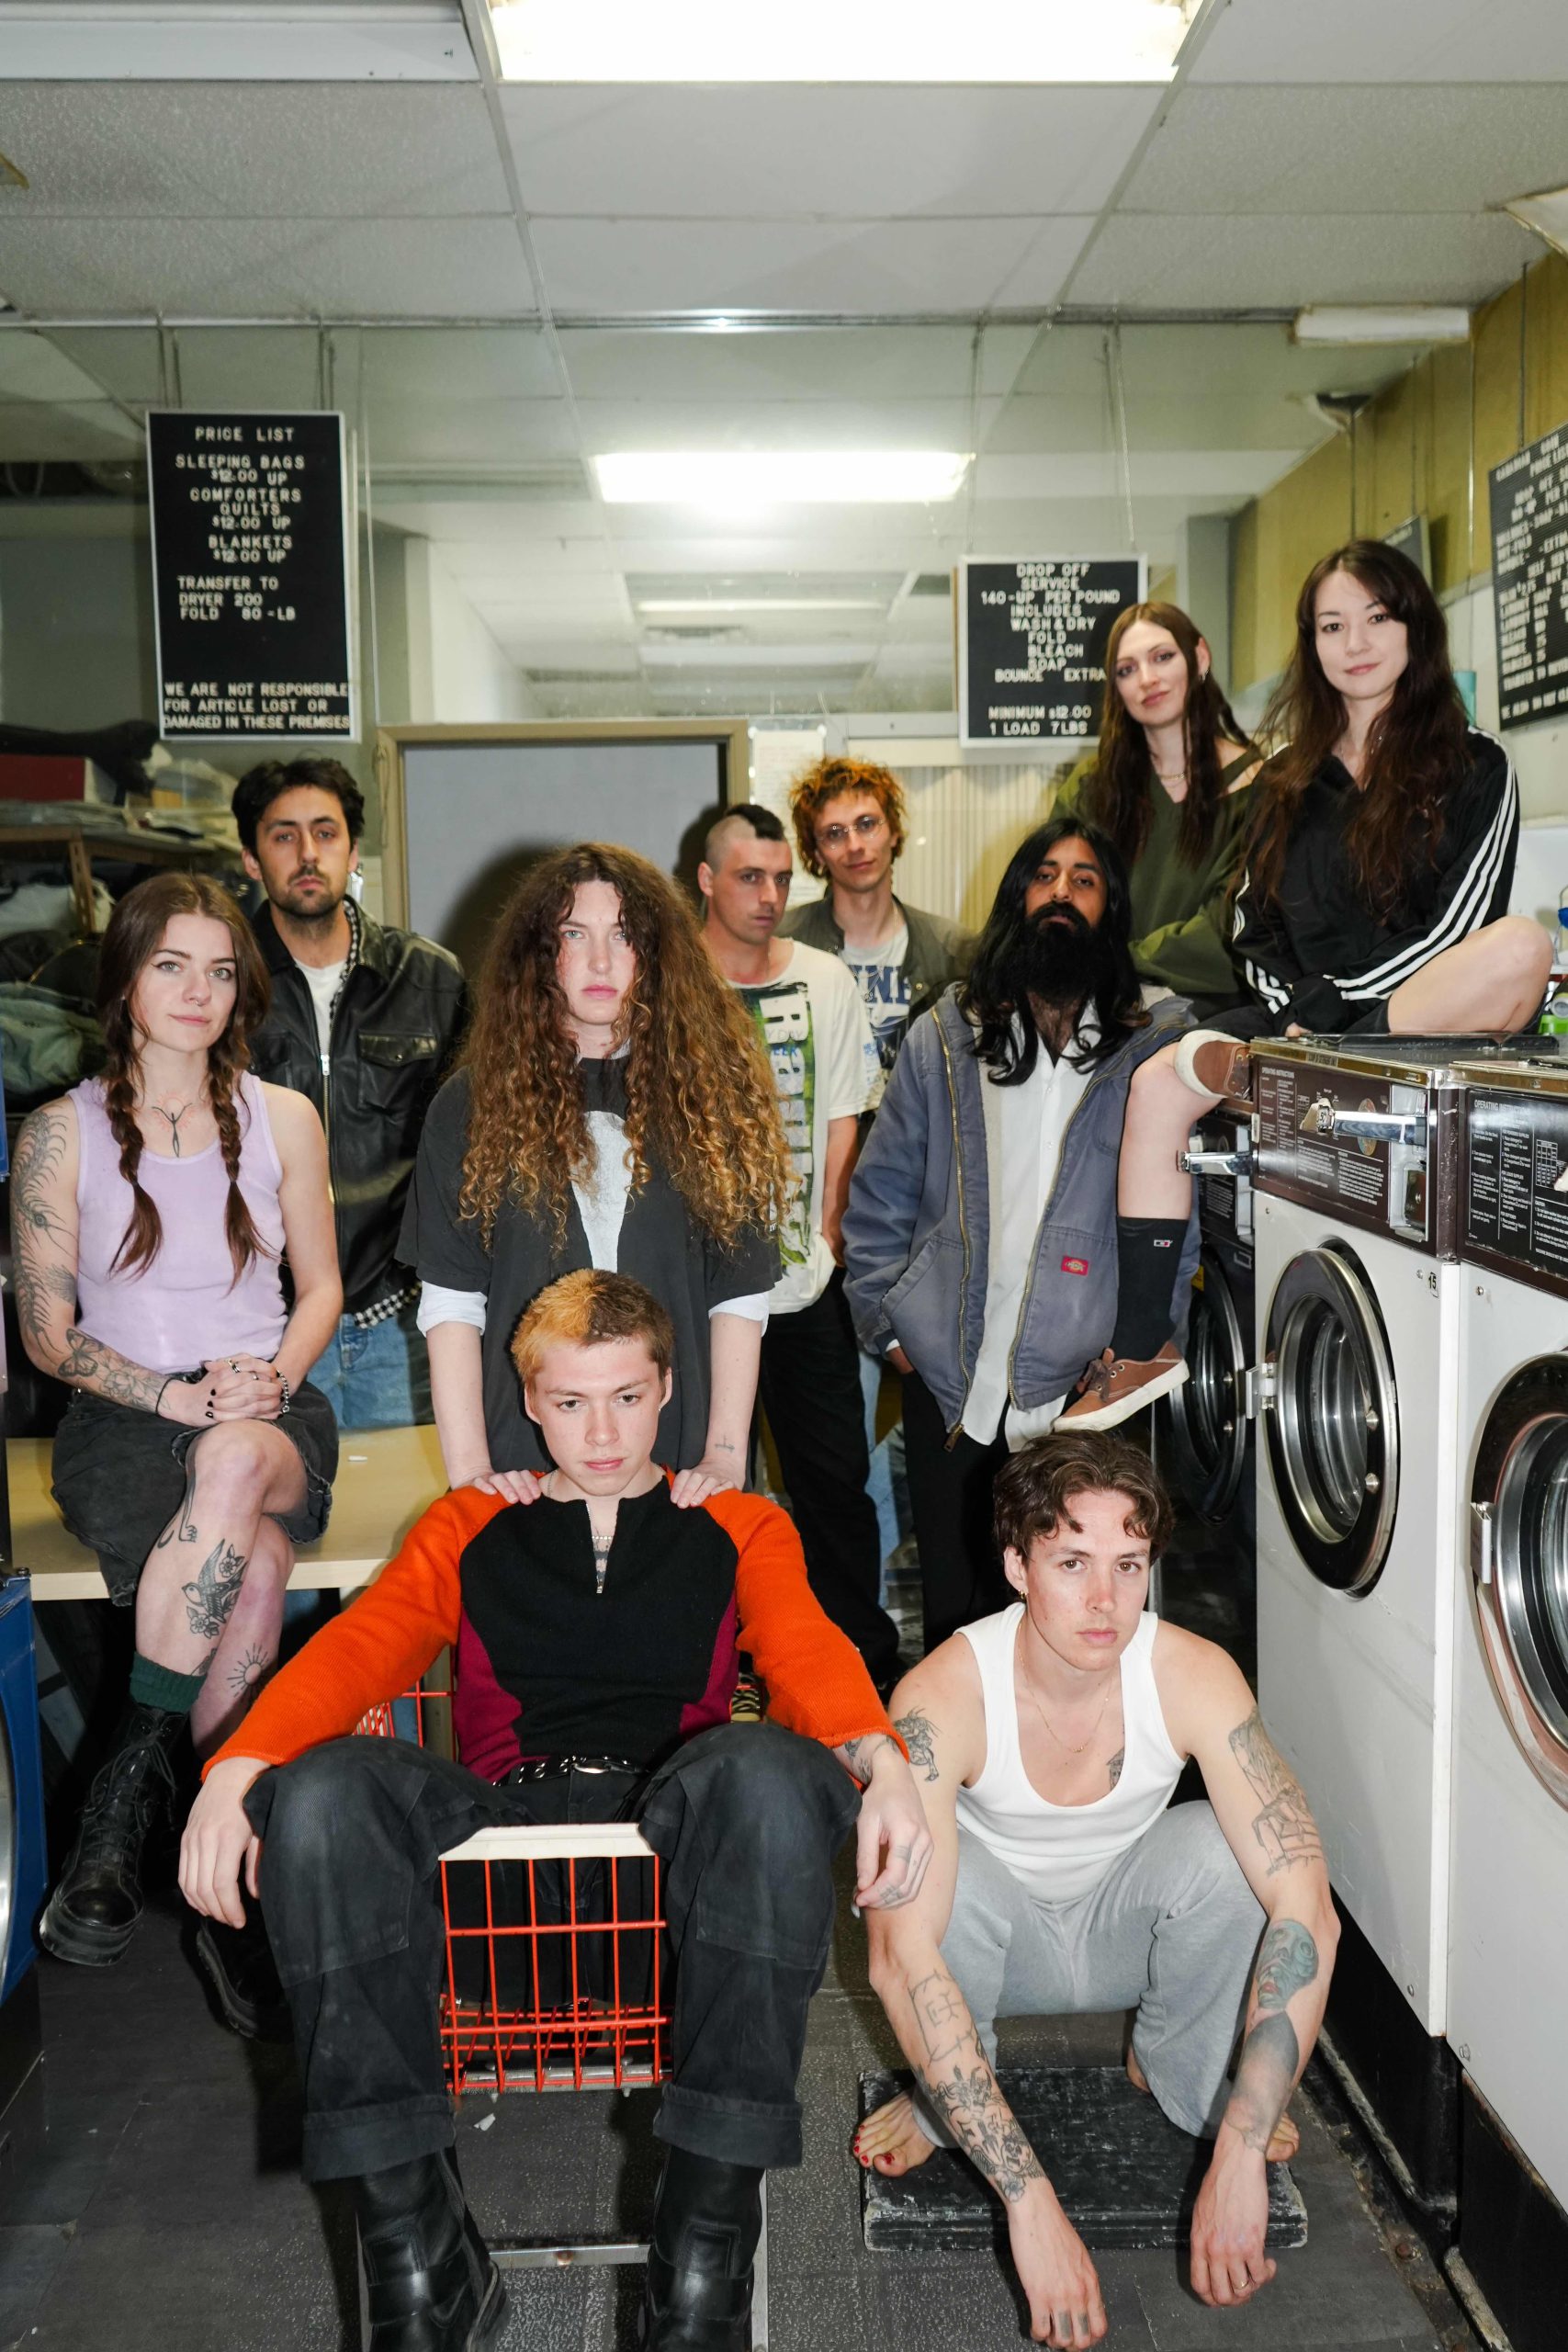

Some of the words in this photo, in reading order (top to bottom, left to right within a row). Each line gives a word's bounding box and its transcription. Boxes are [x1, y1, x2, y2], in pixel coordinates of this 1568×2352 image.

[195, 426, 243, 441] PRICE
[256, 426, 294, 442] LIST
[175, 454, 251, 469] SLEEPING
[260, 454, 305, 469] BAGS
[266, 471, 288, 486] UP
[190, 487, 301, 503] COMFORTERS
[220, 502, 280, 516] QUILTS
[272, 515, 291, 530] UP
[209, 534, 292, 549] BLANKETS
[267, 548, 287, 563] UP
[1016, 563, 1055, 577] DROP
[1062, 563, 1090, 576] OFF
[177, 575, 251, 590] TRANSFER
[259, 575, 279, 591] TO
[1021, 577, 1080, 591] SERVICE
[179, 592, 223, 606] DRYER
[234, 592, 263, 606] 200
[1044, 591, 1072, 604] PER
[1076, 590, 1121, 604] POUND
[180, 606, 220, 620] FOLD
[1010, 604, 1082, 617] INCLUDES
[1010, 617, 1051, 631] WASH
[1066, 617, 1096, 630] DRY
[1028, 630, 1066, 644] FOLD
[1028, 644, 1084, 658] BLEACH
[1028, 658, 1066, 672] SOAP
[995, 669, 1043, 683] BOUNCE
[1064, 668, 1107, 682] EXTRA
[164, 682, 184, 696] WE
[190, 683, 219, 697] ARE
[228, 682, 254, 696] NOT
[260, 682, 348, 697] RESPONSIBLE
[164, 698, 190, 712] FOR
[197, 698, 254, 713] ARTICLE
[261, 698, 298, 713] LOST
[307, 698, 328, 713] OR
[988, 706, 1045, 719] MINIMUM
[164, 715, 221, 729] DAMAGED
[226, 715, 239, 729] IN
[242, 715, 284, 729] THESE
[288, 715, 350, 729] PREMISES
[989, 721, 997, 735] 1
[1003, 720, 1041, 735] LOAD
[1428, 1275, 1437, 1290] 15
